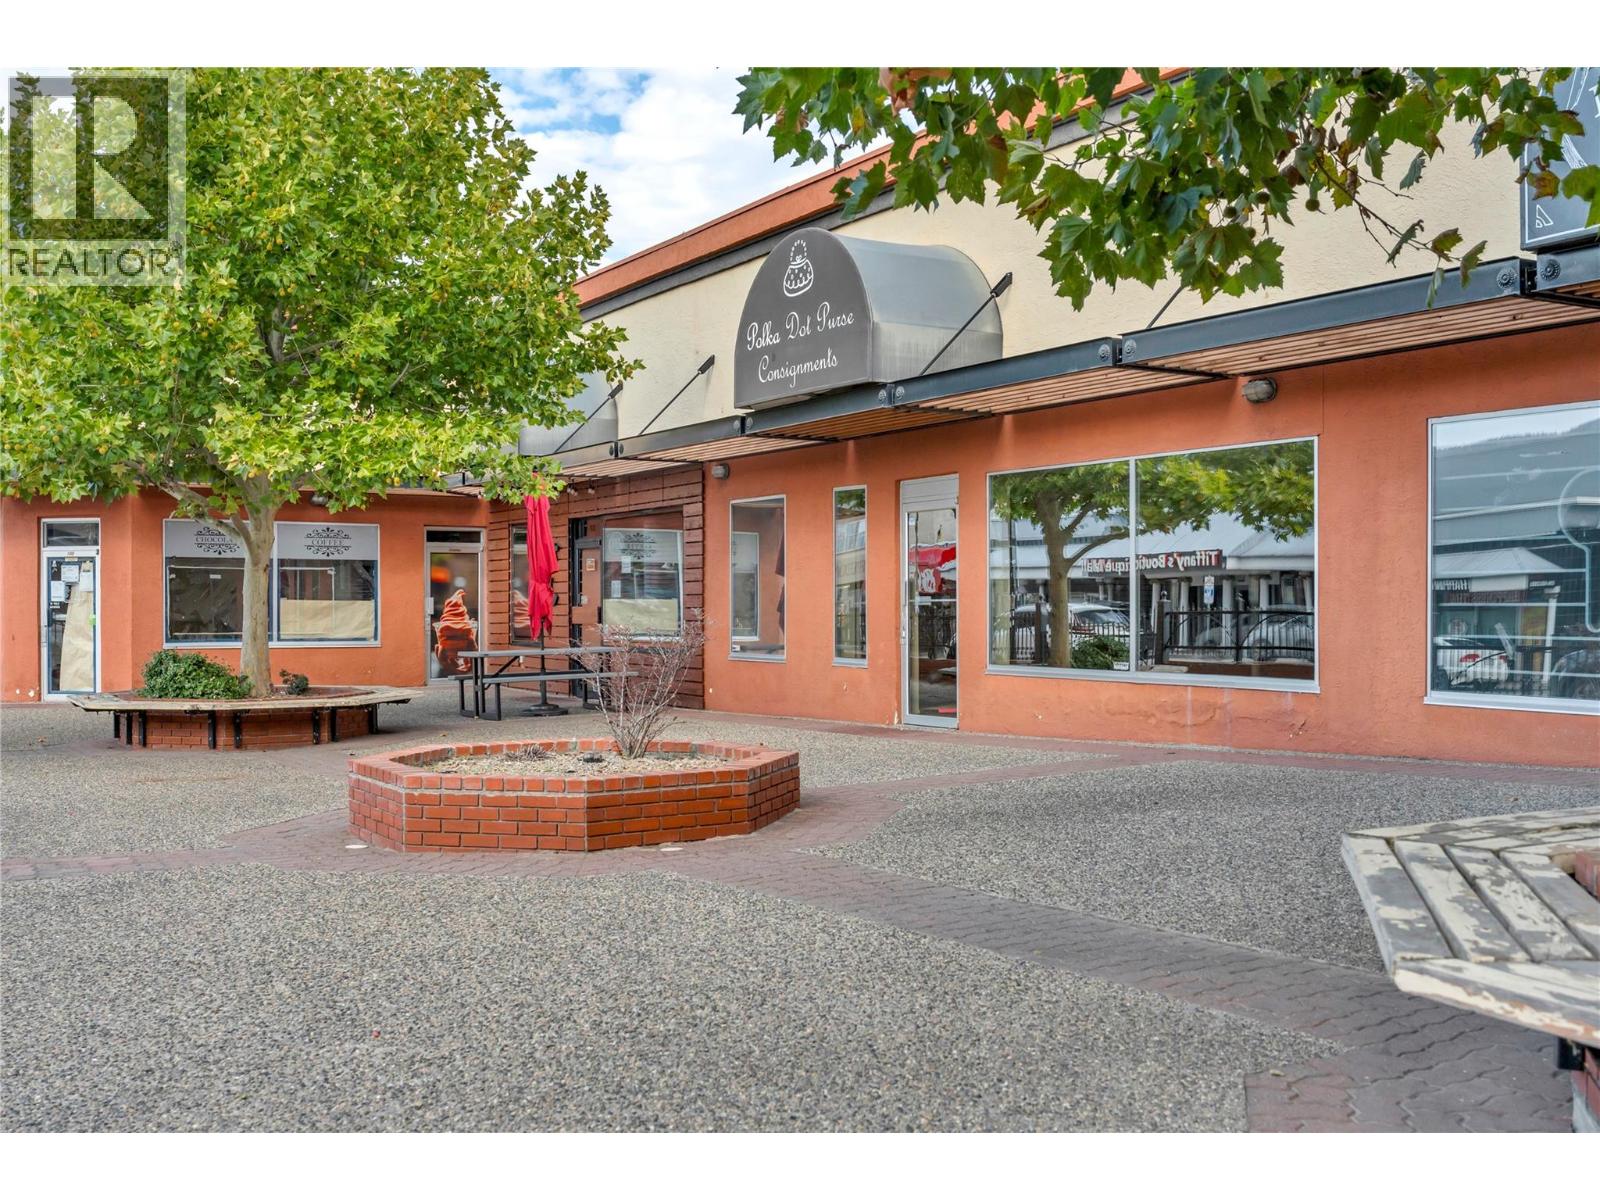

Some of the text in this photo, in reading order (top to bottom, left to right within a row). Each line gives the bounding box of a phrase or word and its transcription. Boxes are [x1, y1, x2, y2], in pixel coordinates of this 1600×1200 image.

[747, 301, 855, 351] Polka Dot Purse
[758, 347, 838, 388] Consignments
